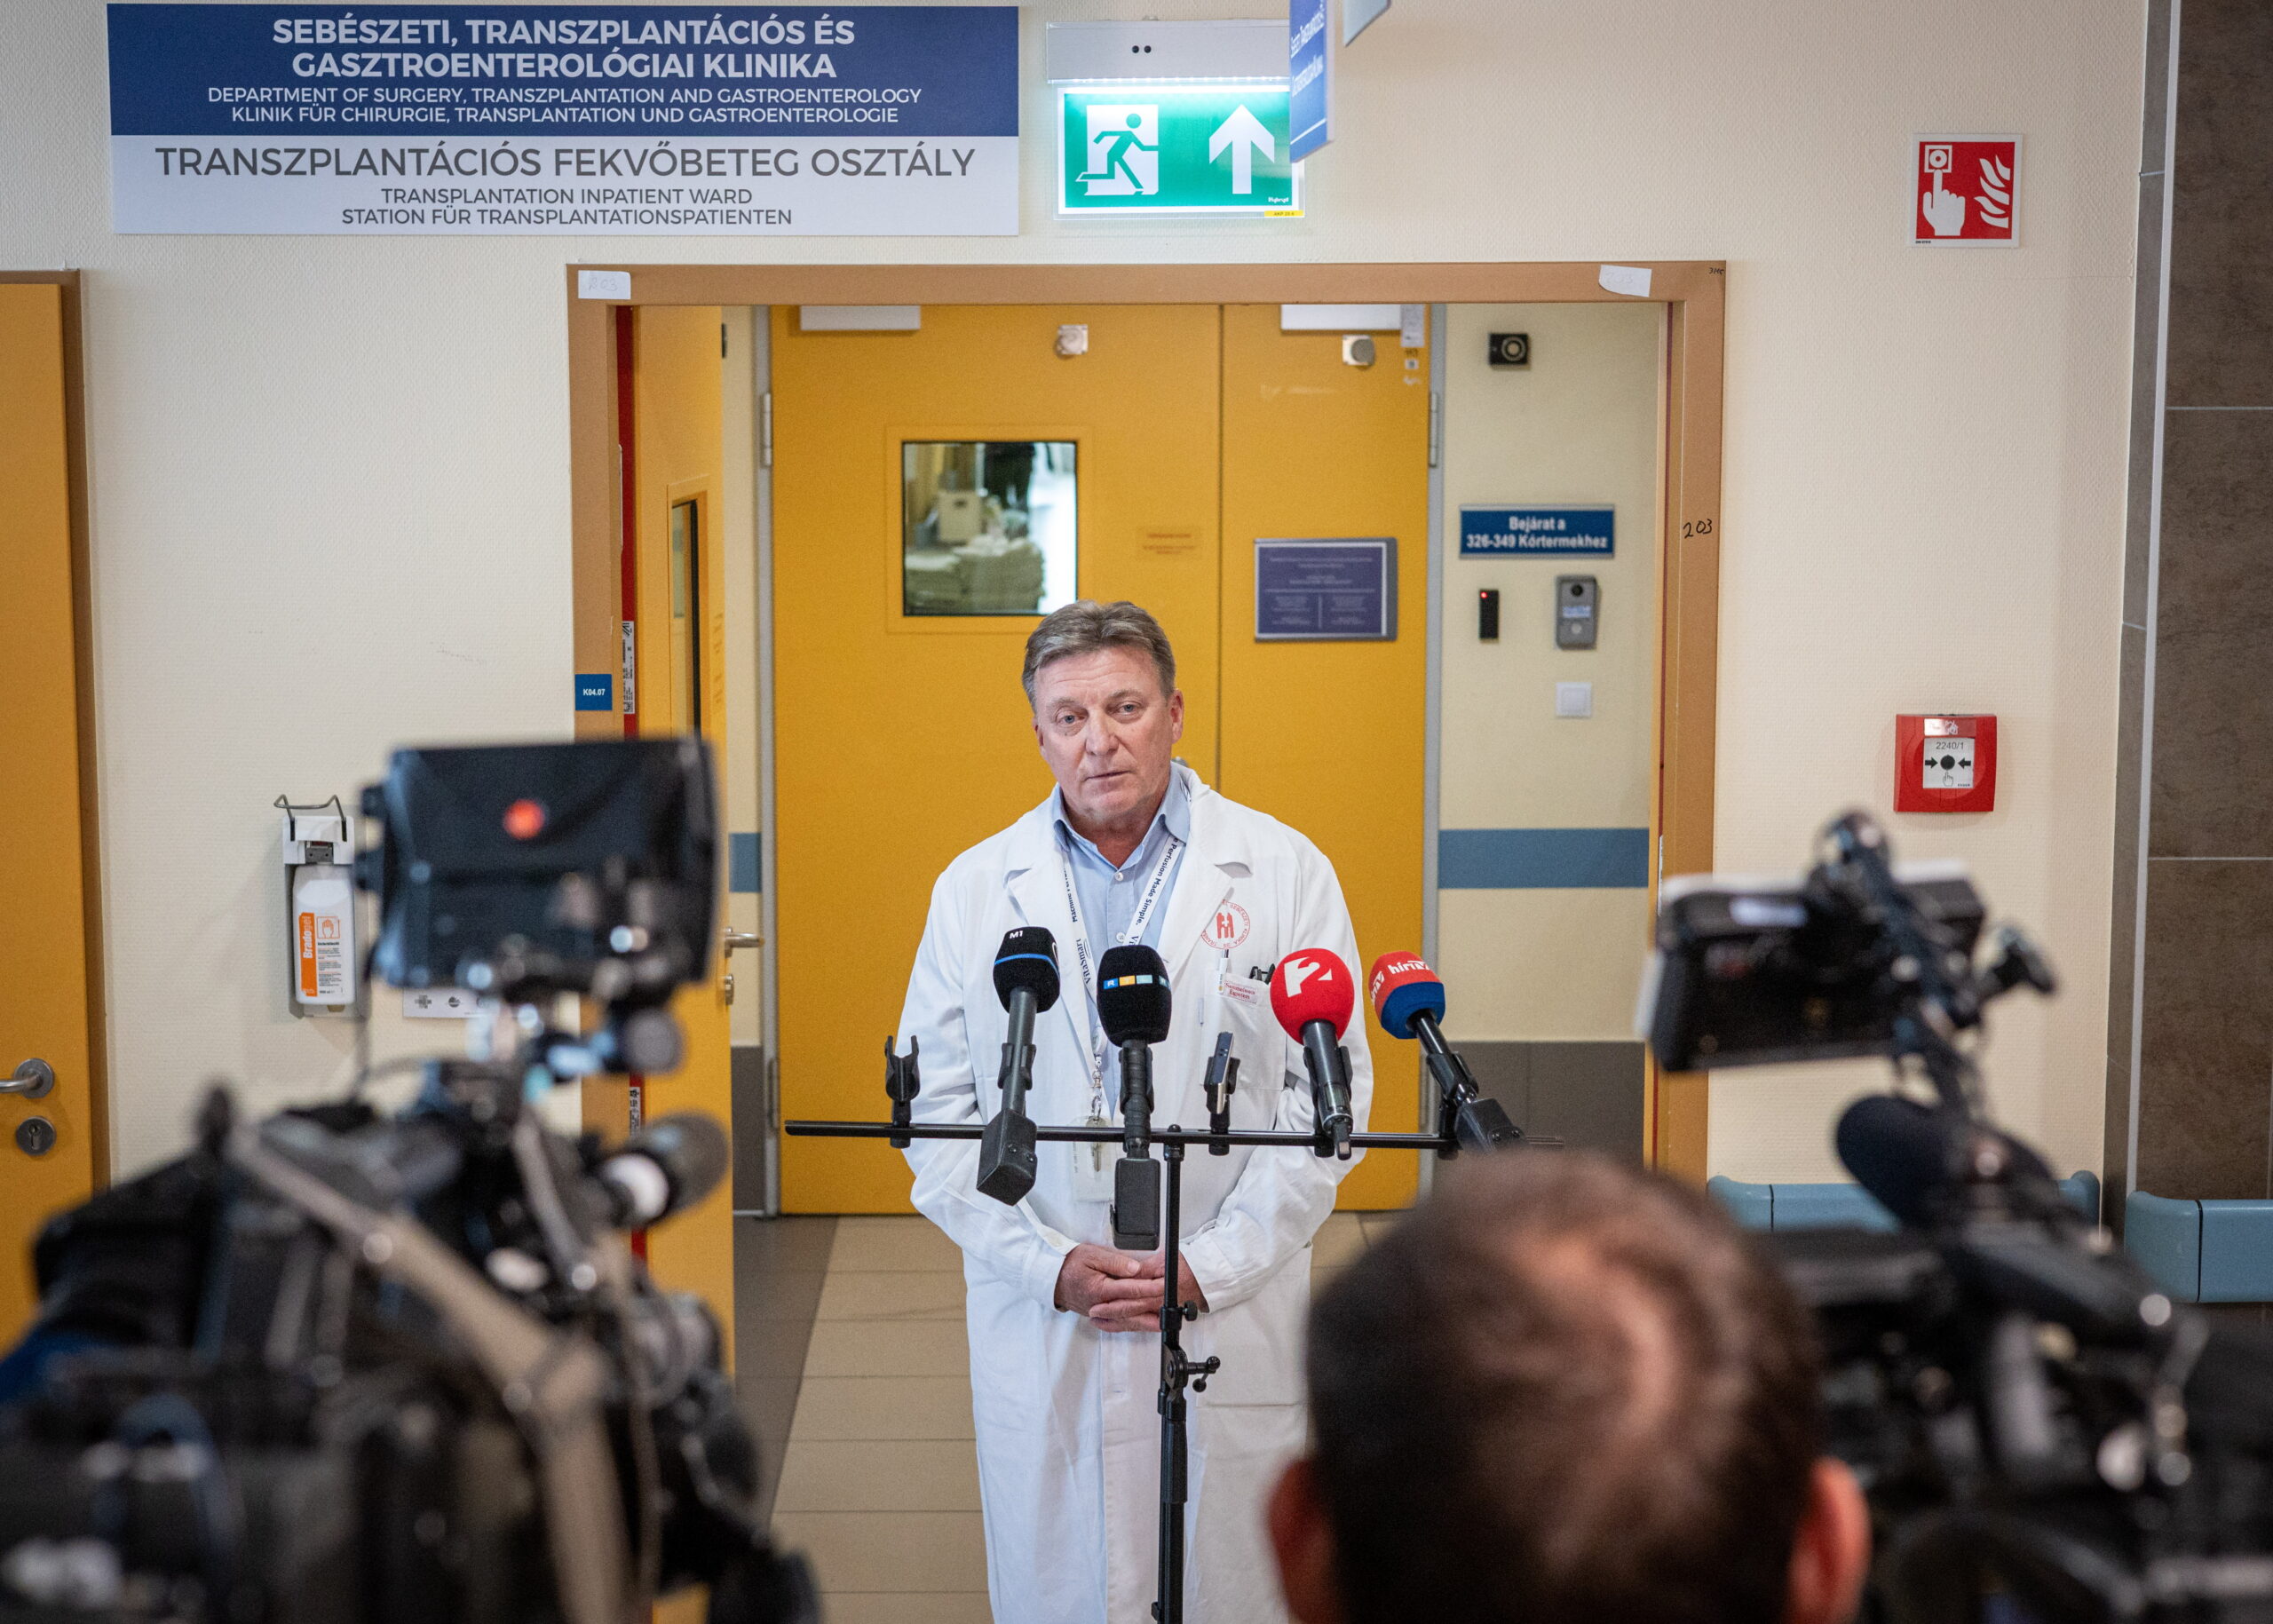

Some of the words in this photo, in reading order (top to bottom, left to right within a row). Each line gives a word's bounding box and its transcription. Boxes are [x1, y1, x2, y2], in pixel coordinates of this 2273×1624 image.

[273, 12, 458, 47] SEBÉSZETI,
[464, 14, 807, 46] TRANSZPLANTÁCIÓS
[814, 14, 855, 45] ÉS
[292, 48, 694, 78] GASZTROENTEROLÓGIAI
[703, 53, 837, 78] KLINIKA
[208, 87, 338, 104] DEPARTMENT
[343, 87, 368, 103] OF
[373, 87, 467, 105] SURGERY,
[471, 88, 664, 104] TRANSZPLANTATION
[669, 88, 713, 104] AND
[717, 88, 923, 104] GASTROENTEROLOGY
[232, 107, 293, 123] KLINIK
[298, 105, 336, 123] FÜR
[341, 107, 450, 124] CHIRURGIE,
[454, 107, 636, 123] TRANSPLANTATION
[641, 107, 685, 123] UND
[688, 107, 899, 123] GASTROENTEROLOGIE
[154, 140, 542, 177] TRANSZPLANTÁCIÓS
[554, 140, 799, 177] FEKVŐBETEG
[811, 140, 976, 177] OSZTÁLY
[380, 187, 574, 205] TRANSPLANTATION
[581, 188, 685, 204] INPATIENT
[689, 188, 753, 204] WARD
[342, 209, 425, 225] STATION
[432, 204, 471, 225] FÜR
[476, 209, 792, 225] TRANSPLANTATIONSPATIENTEN
[1509, 516, 1555, 533] Bejárat
[1556, 519, 1566, 531] a
[1683, 519, 1713, 539] 203
[1518, 534, 1608, 549] Kórtermekhez
[1936, 741, 1965, 750] 2240/1
[1157, 843, 1177, 877] Perfusion
[1148, 878, 1161, 898] Made
[1136, 899, 1152, 926] Simple.
[1010, 931, 1024, 939] M1
[1075, 938, 1091, 984] VitaSmart
